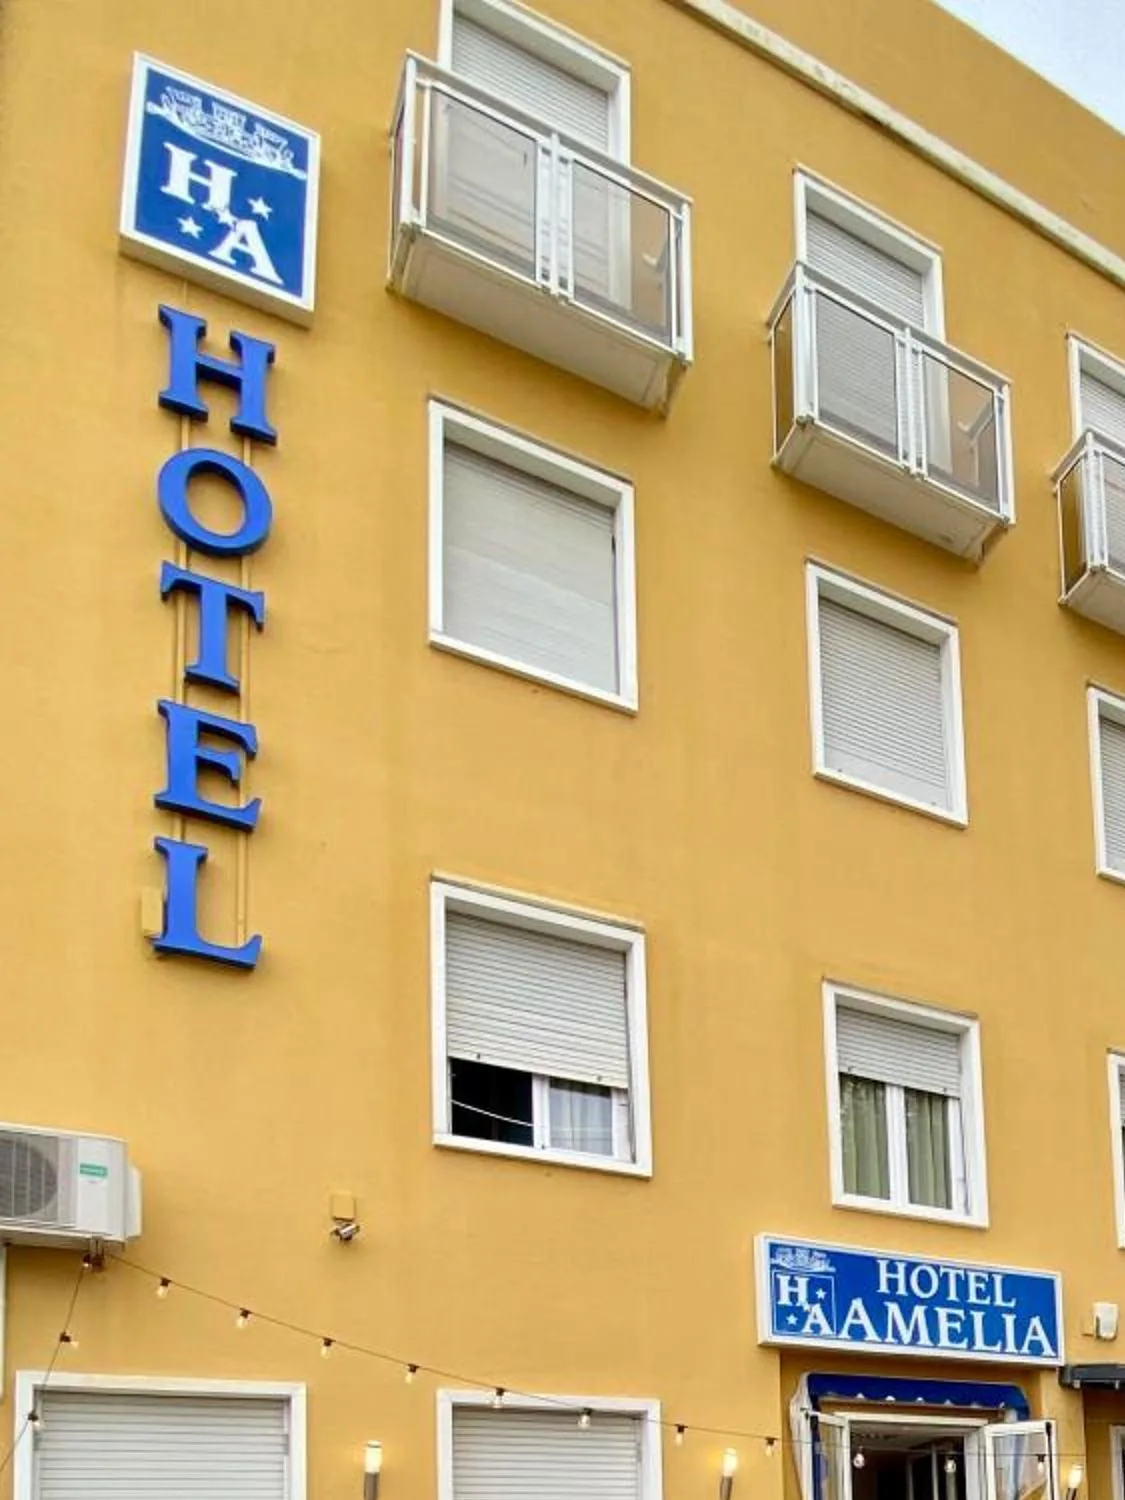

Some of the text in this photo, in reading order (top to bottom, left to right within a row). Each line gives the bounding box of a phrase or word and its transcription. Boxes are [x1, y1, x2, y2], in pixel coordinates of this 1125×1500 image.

[154, 303, 278, 970] HOTEL
[876, 1259, 1017, 1308] HOTEL
[838, 1297, 1056, 1358] AMELIA
